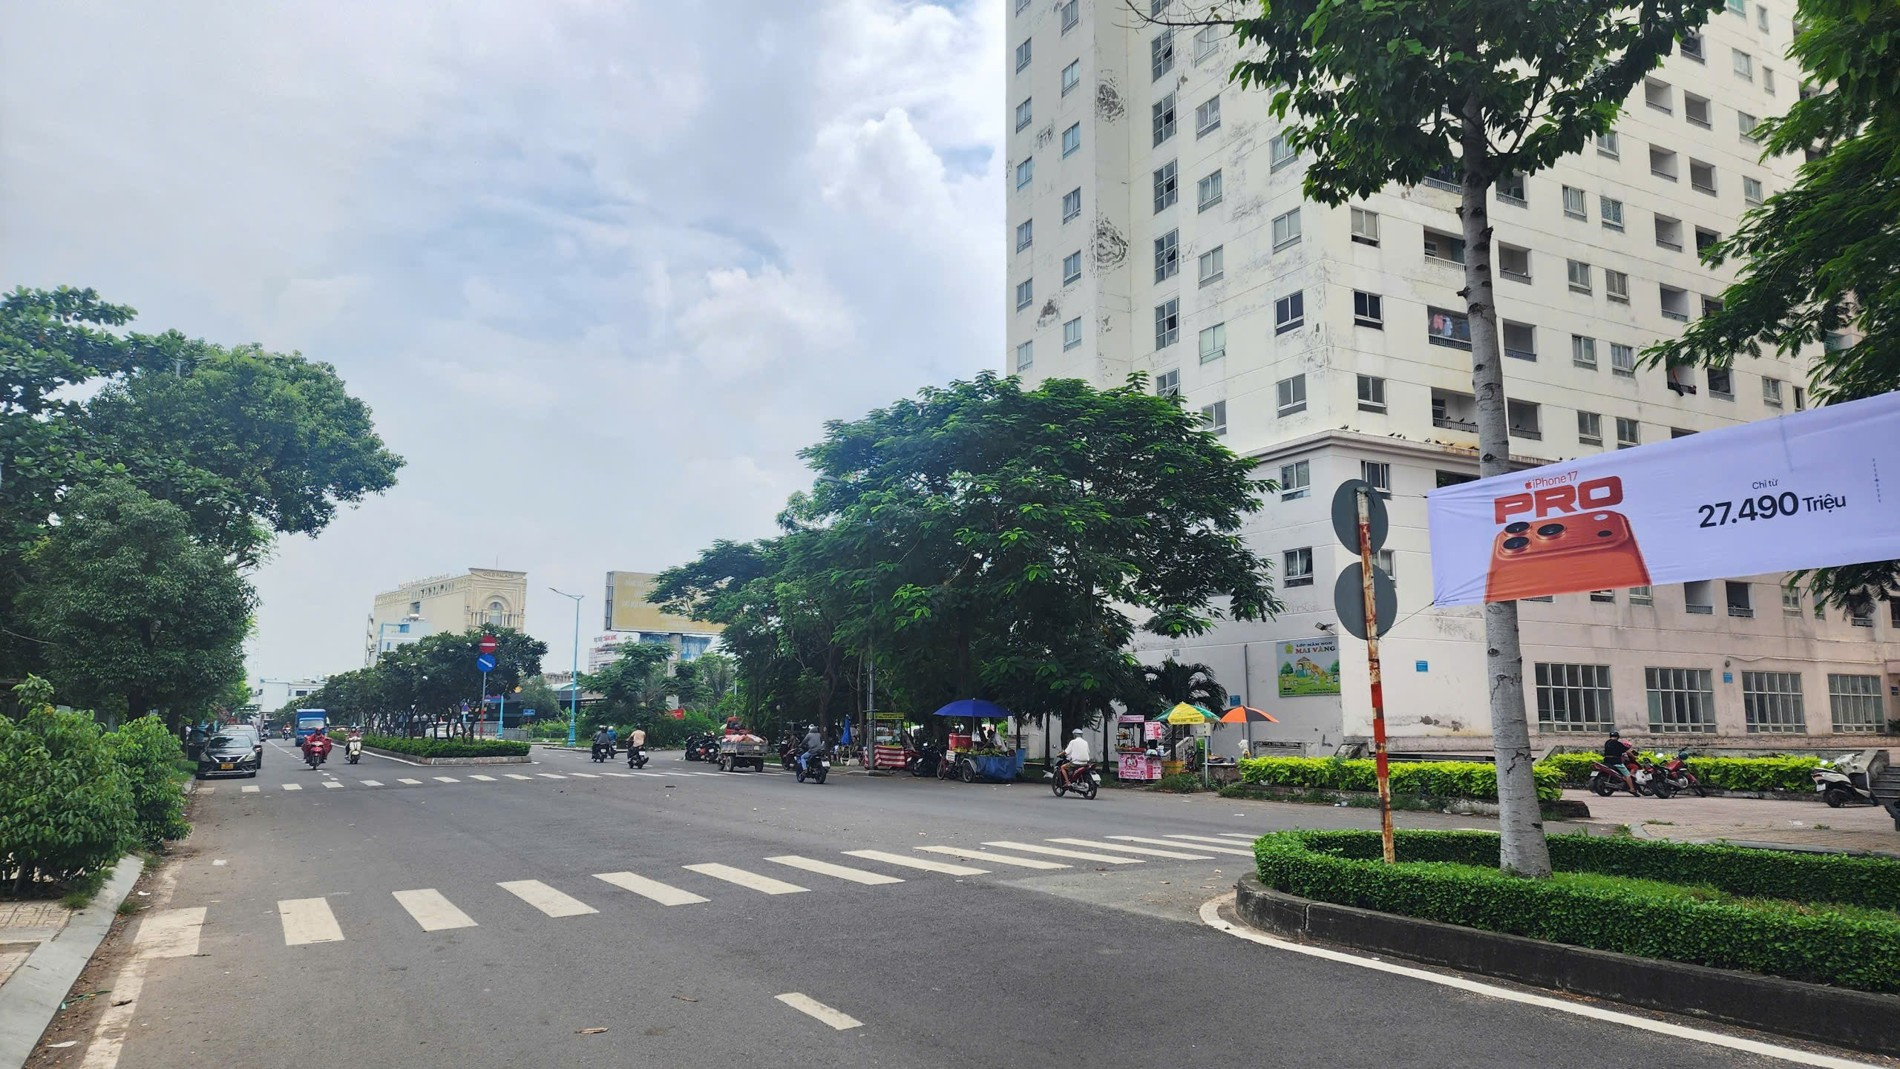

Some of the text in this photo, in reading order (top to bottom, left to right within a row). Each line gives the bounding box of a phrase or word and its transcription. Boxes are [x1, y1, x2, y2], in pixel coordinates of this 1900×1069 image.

[1532, 470, 1578, 489] iPhone 17
[1768, 478, 1779, 488] từ
[1494, 476, 1623, 525] PRO
[1698, 491, 1846, 528] 27.490 Triệu
